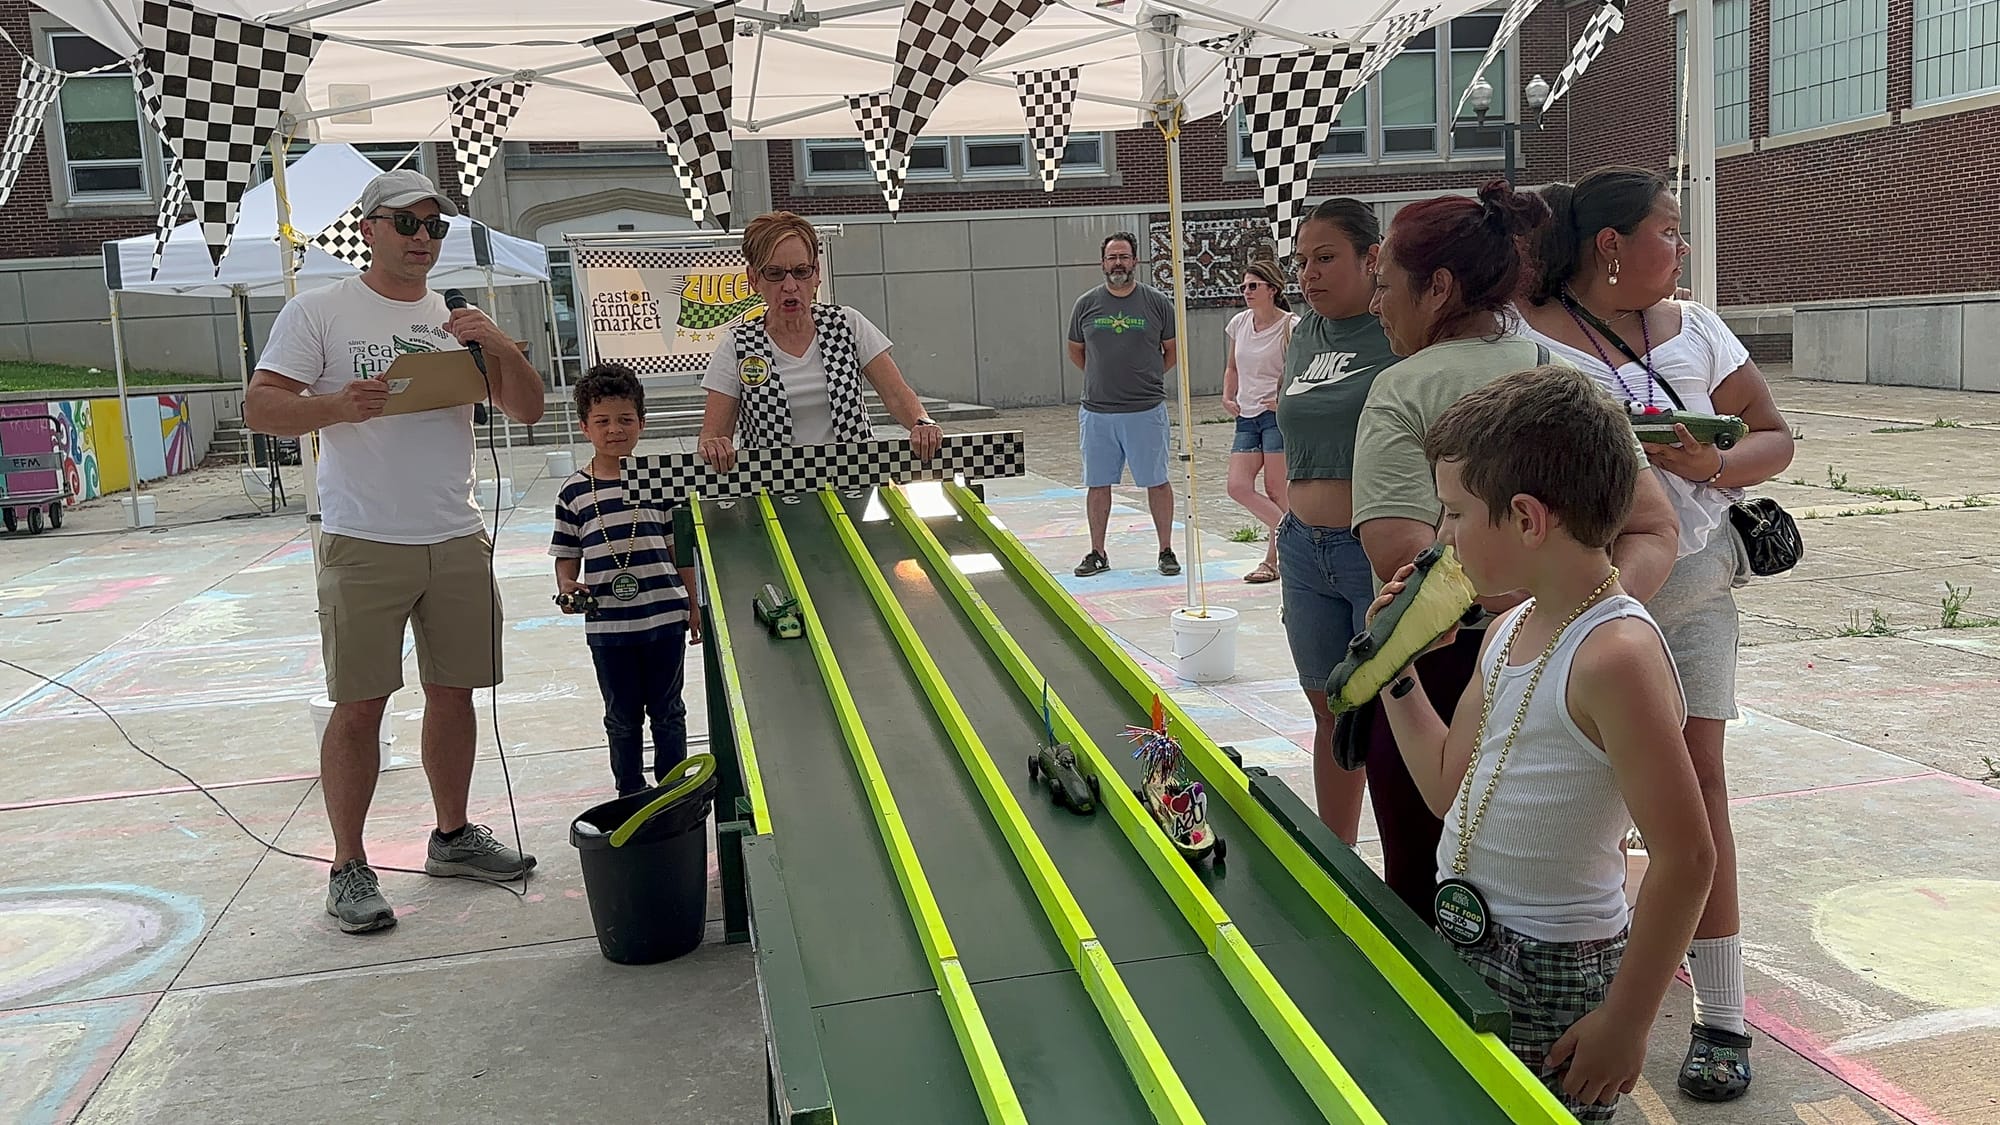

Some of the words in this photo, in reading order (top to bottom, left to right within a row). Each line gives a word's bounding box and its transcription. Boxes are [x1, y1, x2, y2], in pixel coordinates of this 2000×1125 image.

[598, 290, 651, 303] easton
[681, 273, 757, 304] ZUCC
[592, 298, 660, 318] farmers'
[593, 314, 662, 332] market
[1302, 351, 1358, 381] NIKE
[13, 458, 41, 468] EFM
[1441, 900, 1460, 913] FAST
[1462, 909, 1482, 923] FOOD
